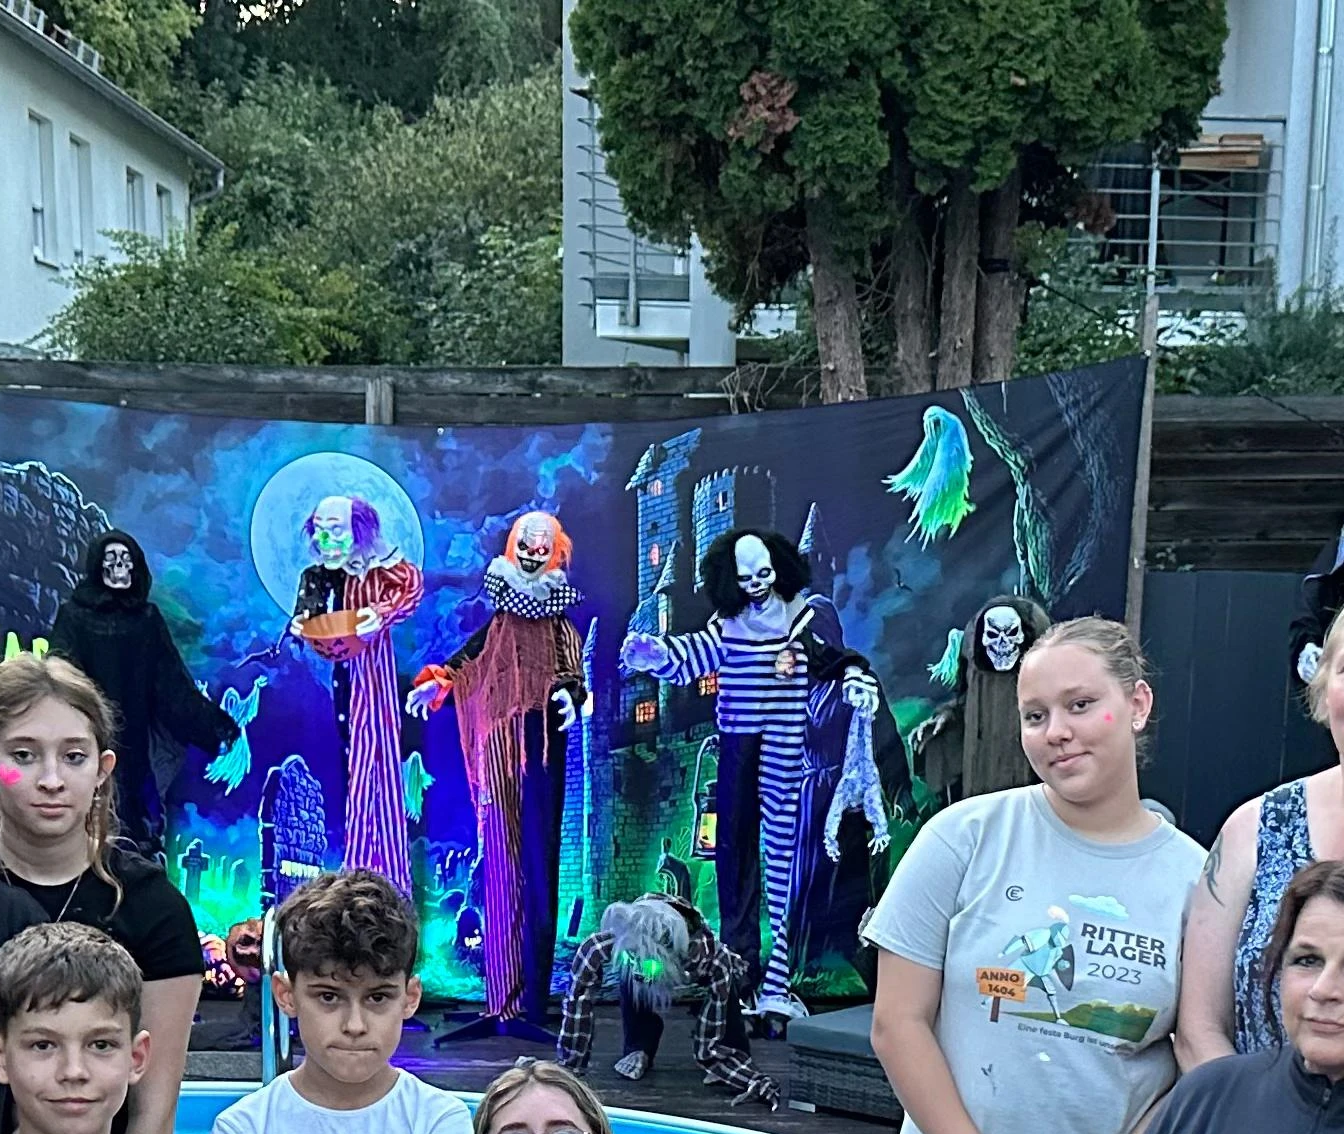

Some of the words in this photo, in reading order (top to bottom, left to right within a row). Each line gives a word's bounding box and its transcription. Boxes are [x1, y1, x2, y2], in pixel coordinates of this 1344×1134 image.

[1080, 922, 1166, 954] RITTER
[1085, 939, 1167, 970] LAGER
[979, 970, 1021, 983] ANNO
[1086, 962, 1143, 985] 2023
[987, 983, 1017, 998] 1404
